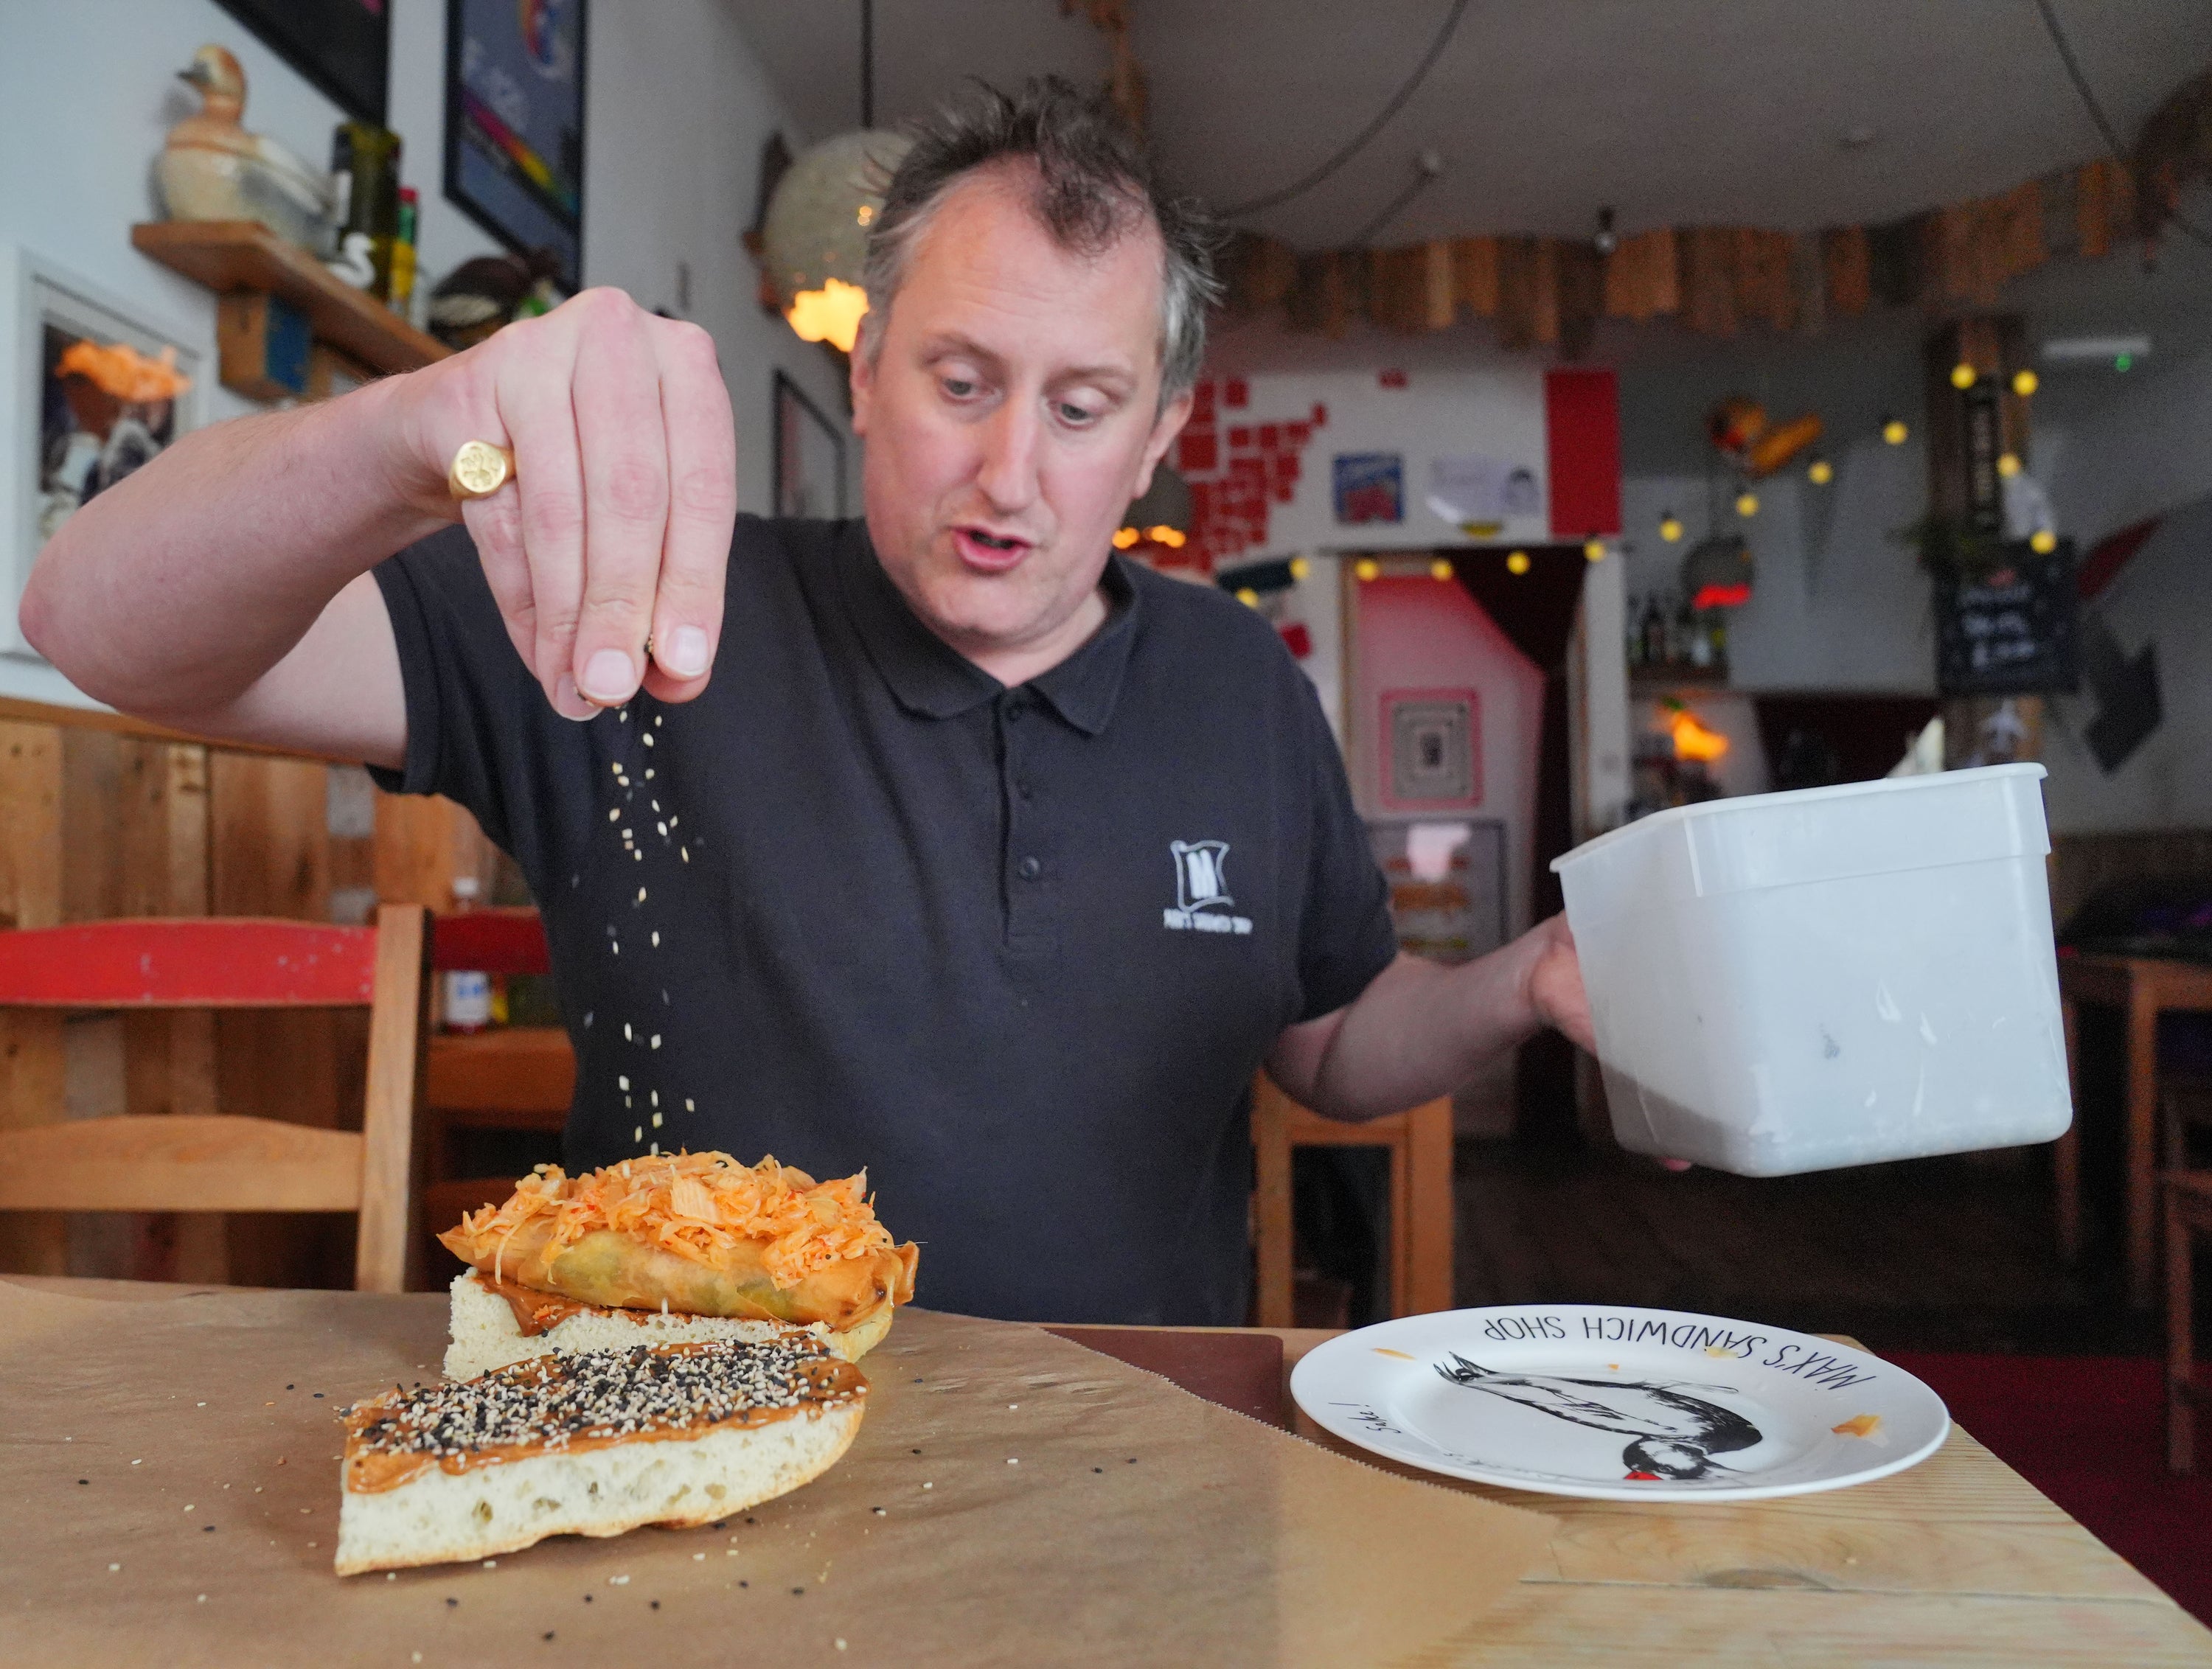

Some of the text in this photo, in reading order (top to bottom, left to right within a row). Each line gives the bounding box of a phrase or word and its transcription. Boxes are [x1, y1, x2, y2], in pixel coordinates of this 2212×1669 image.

[1484, 1316, 1877, 1390] MAX'S SANDWICH SHOP
